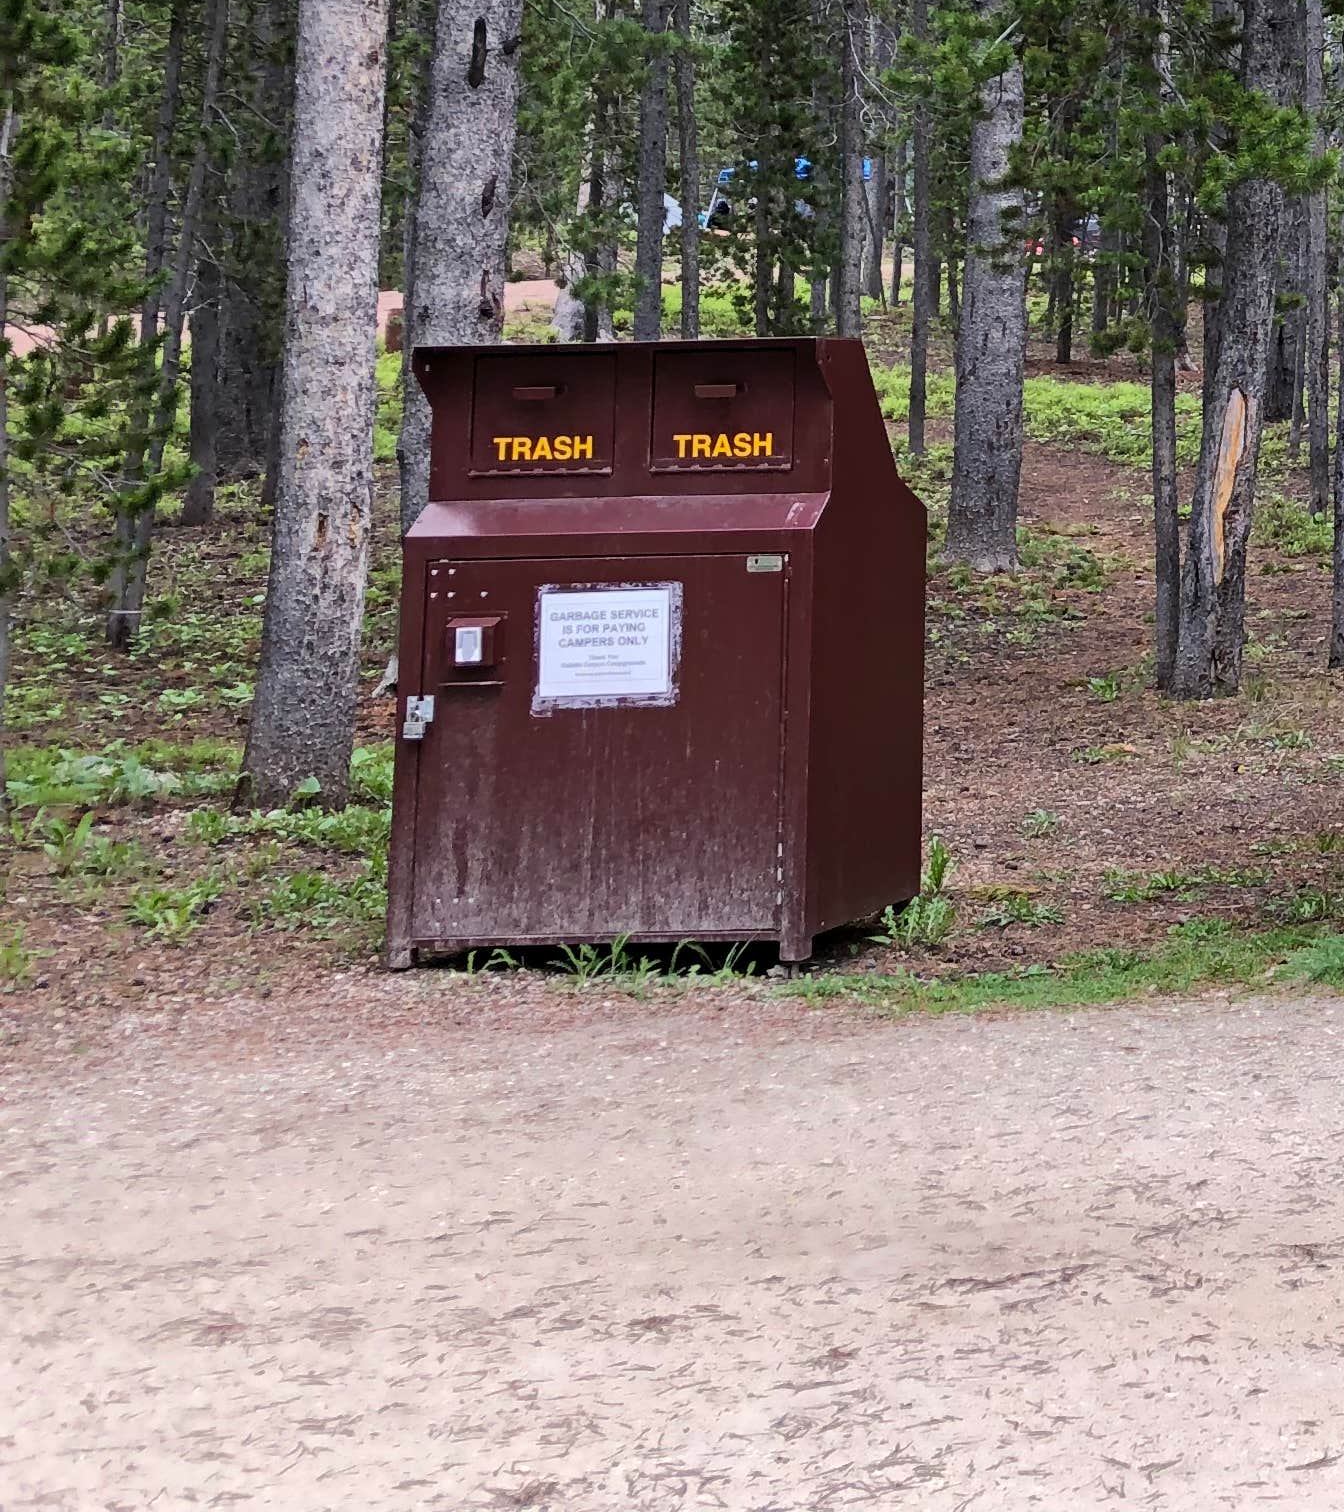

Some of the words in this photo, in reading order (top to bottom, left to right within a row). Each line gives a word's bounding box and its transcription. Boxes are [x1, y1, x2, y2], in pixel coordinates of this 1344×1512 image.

[494, 435, 593, 461] TRASH
[673, 432, 773, 458] TRASH
[550, 610, 607, 621] GARBAGE
[610, 608, 660, 620] SERVICE
[562, 625, 573, 635] IS
[576, 624, 600, 634] FOR
[603, 622, 646, 633] PAYING
[558, 637, 614, 648] CAMPERS
[618, 635, 649, 647] ONLY
